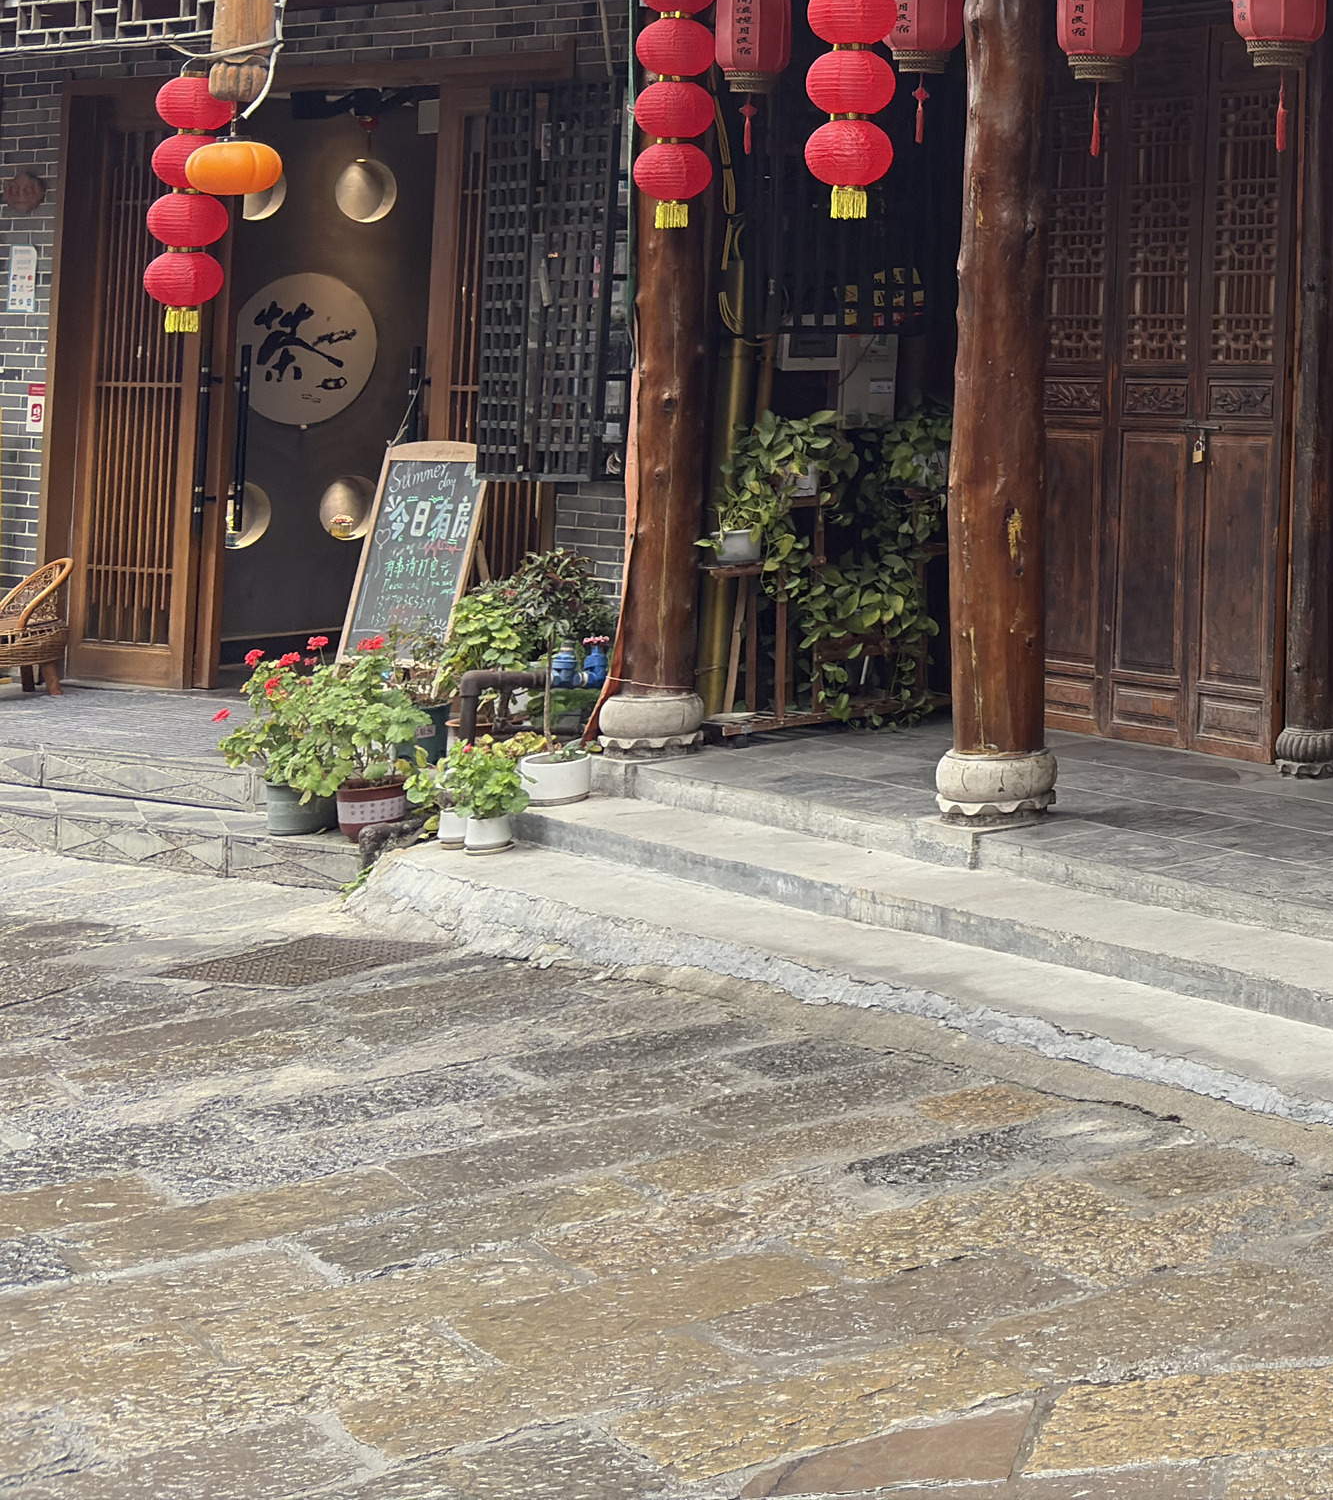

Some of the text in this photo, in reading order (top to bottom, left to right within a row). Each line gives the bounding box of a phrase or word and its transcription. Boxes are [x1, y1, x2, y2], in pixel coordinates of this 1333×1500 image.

[388, 462, 450, 494] Summer
[389, 496, 472, 540] 今日有房
